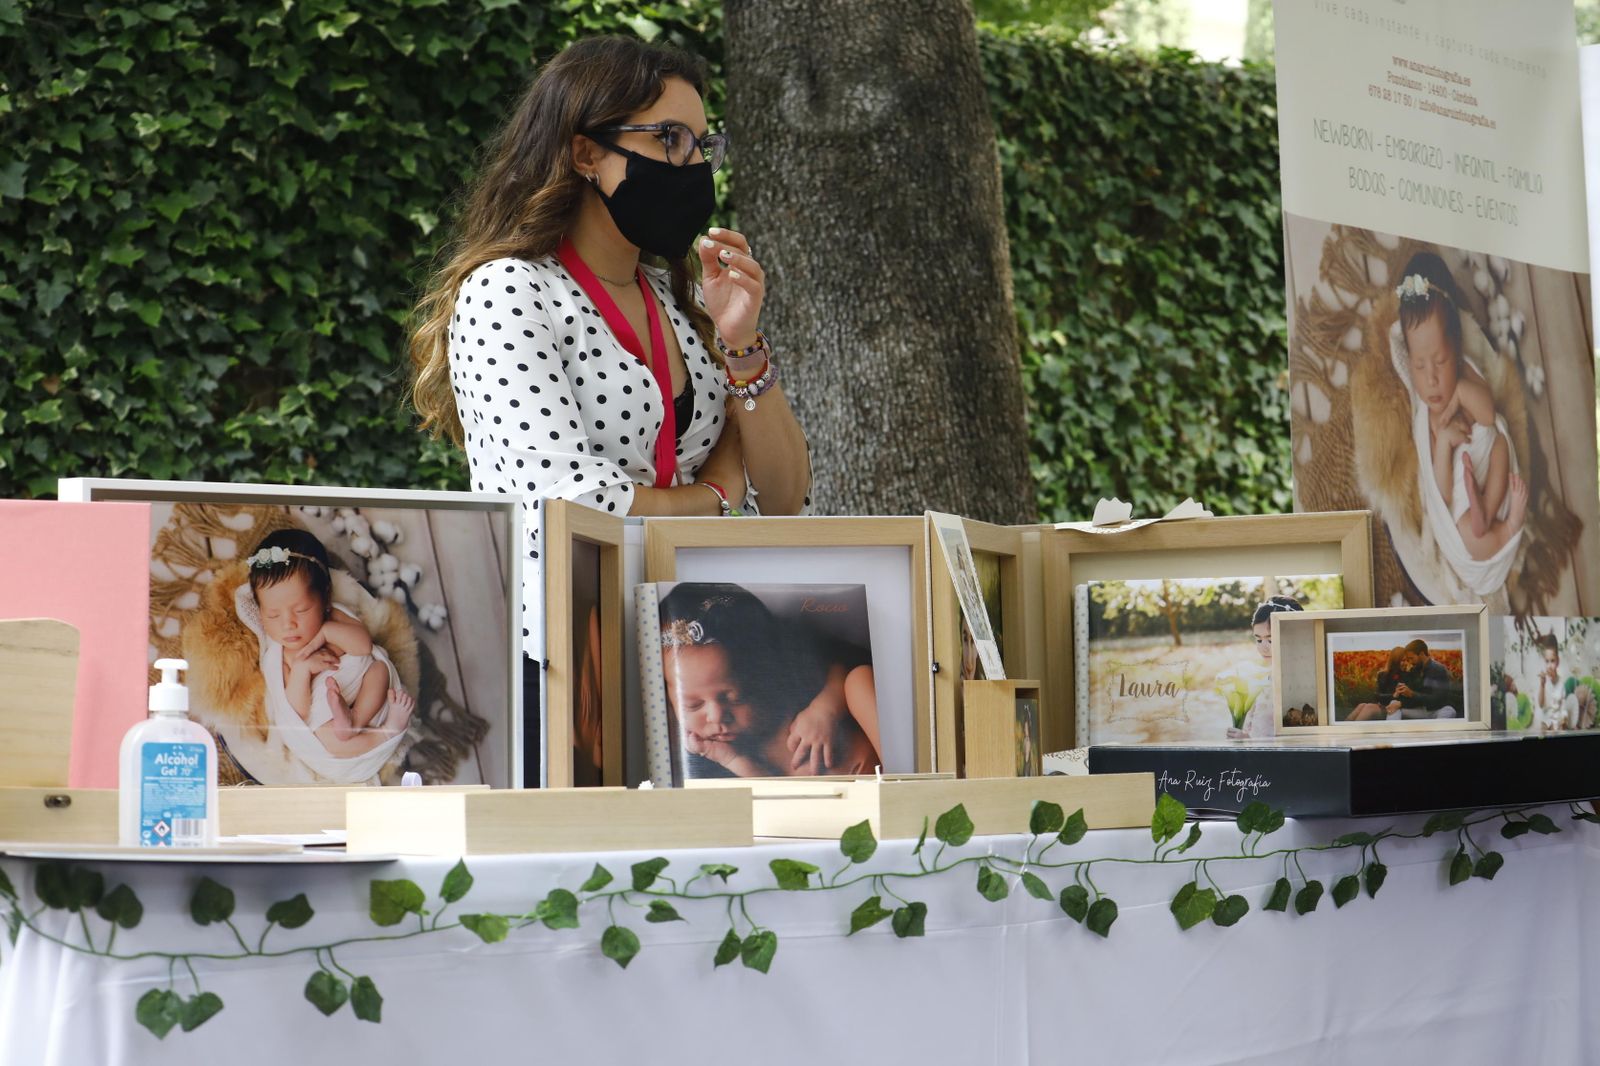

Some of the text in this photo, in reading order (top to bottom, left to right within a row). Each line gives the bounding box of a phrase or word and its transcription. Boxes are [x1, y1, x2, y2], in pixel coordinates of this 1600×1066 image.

[1344, 6, 1369, 25] cada
[1375, 17, 1420, 40] instante
[1313, 117, 1374, 153] NEWBORN
[1399, 177, 1464, 214] COMUNIONES
[1475, 194, 1519, 227] EVENTOS
[1119, 673, 1180, 699] Laura
[154, 752, 199, 766] Alcohol
[160, 766, 178, 776] Gel
[1158, 770, 1181, 793] Ana
[1184, 769, 1215, 802] Ruiz
